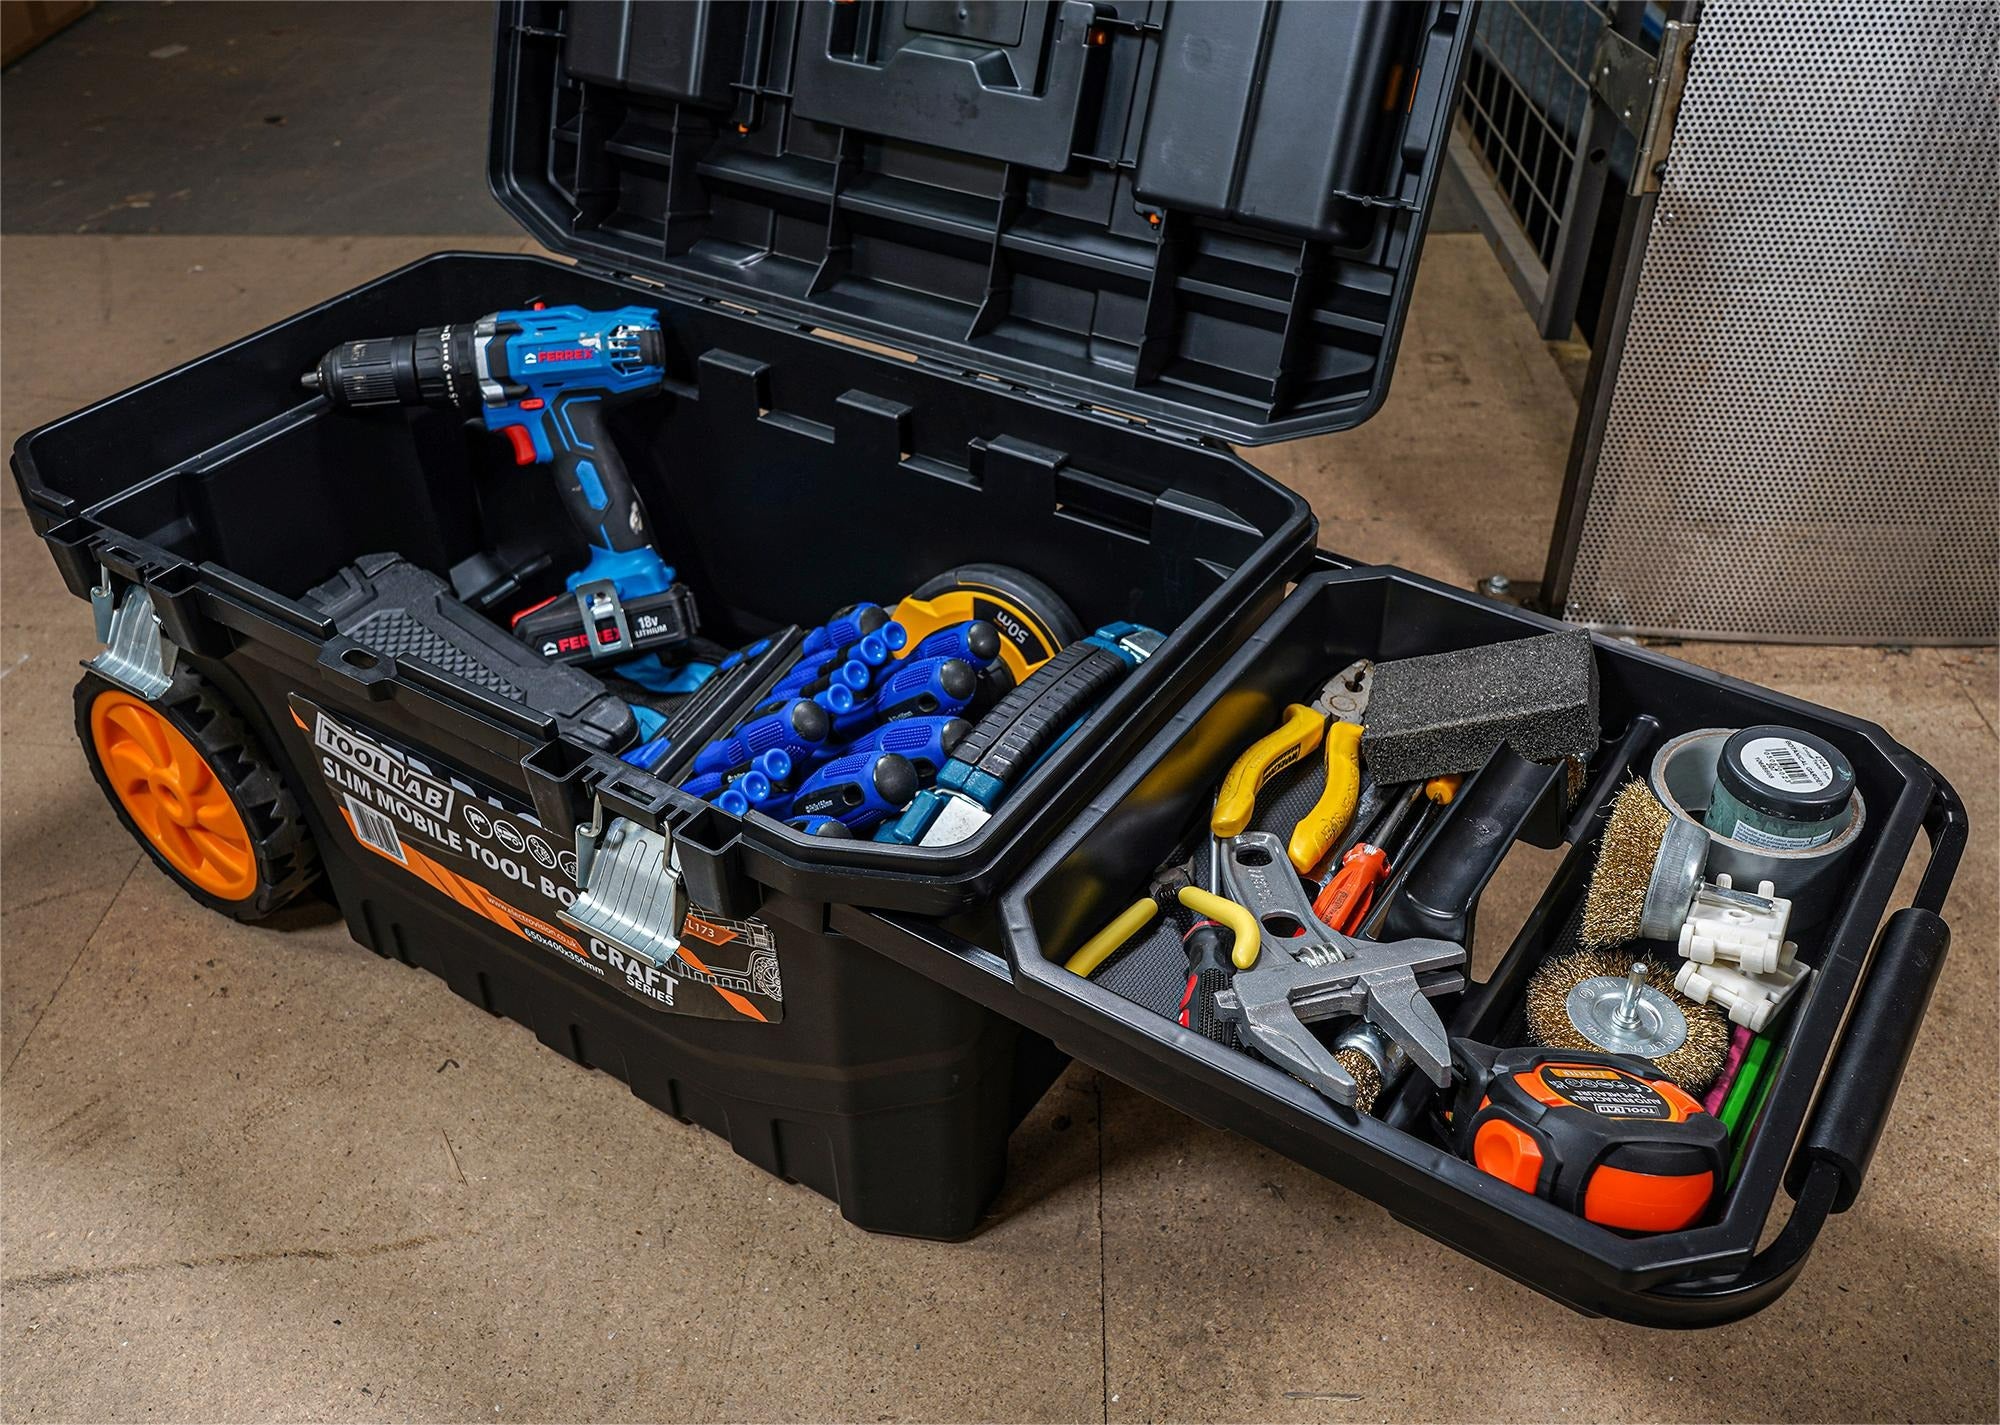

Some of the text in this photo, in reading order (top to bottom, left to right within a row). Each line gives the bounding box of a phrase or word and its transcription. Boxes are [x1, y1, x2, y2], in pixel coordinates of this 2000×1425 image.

[538, 348, 594, 363] FERREX
[634, 624, 668, 638] LITHIUM
[996, 610, 1030, 646] 50m
[1785, 740, 1824, 786] BOTANICAL GARDEN
[322, 756, 373, 801] SLIM
[376, 788, 463, 853] MOBILE
[465, 837, 536, 889] TOOL
[540, 876, 580, 907] BO
[486, 896, 578, 948] www.electrovision.co.uk
[524, 927, 605, 976] 650x400x350mm
[590, 937, 679, 997] CRAFT
[626, 975, 674, 1007] SERIES
[1570, 1095, 1633, 1104] RETRACTABLE
[1574, 1090, 1622, 1098] MEASURE
